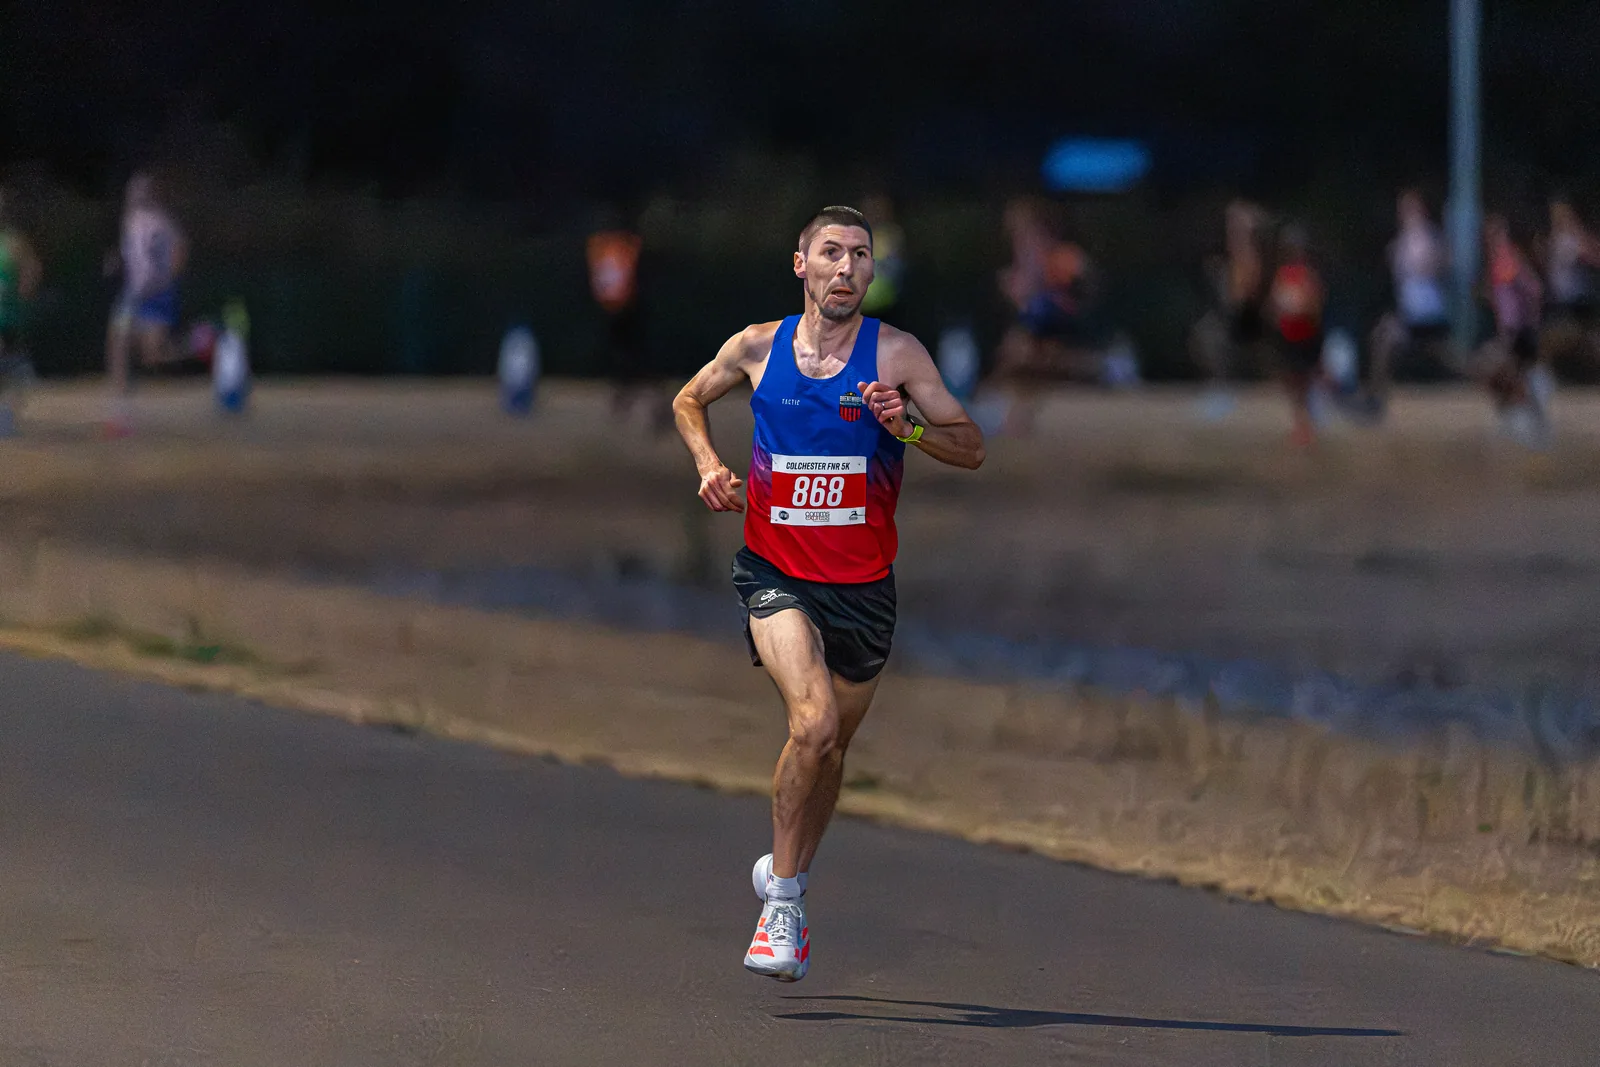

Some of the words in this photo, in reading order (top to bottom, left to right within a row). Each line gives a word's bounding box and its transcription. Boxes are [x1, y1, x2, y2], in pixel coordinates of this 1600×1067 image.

[786, 462, 826, 470] COLCHESTER
[827, 462, 841, 470] FNR
[841, 462, 850, 470] 5K
[792, 476, 845, 507] 868
